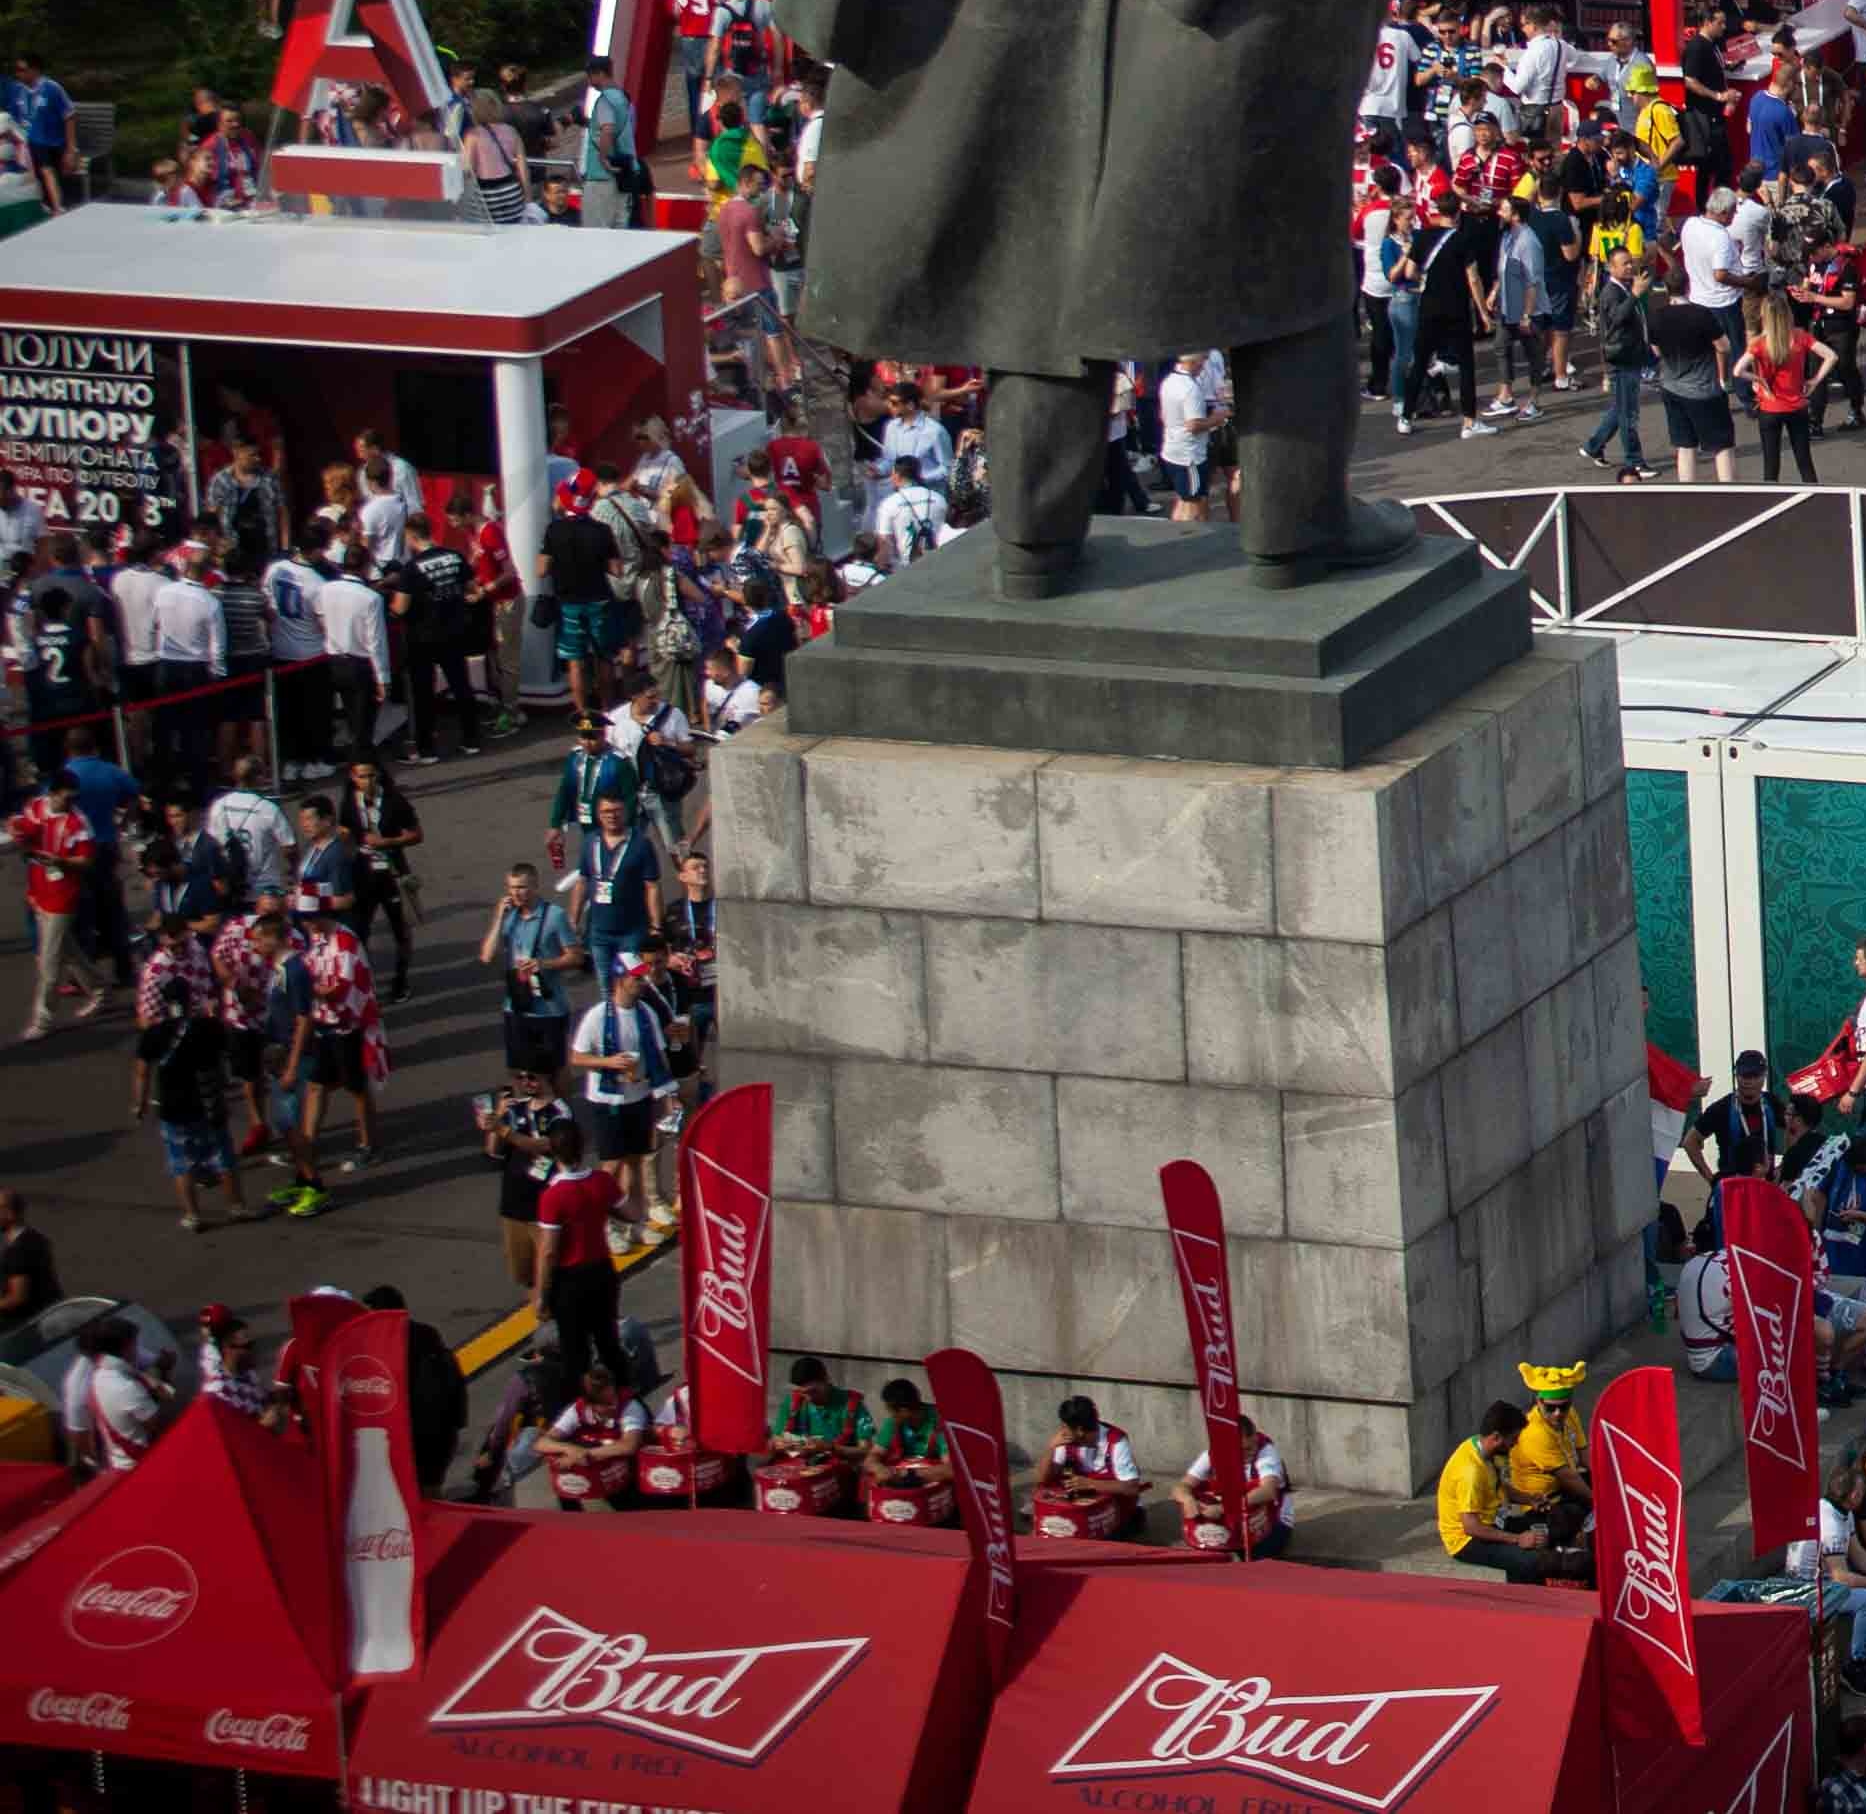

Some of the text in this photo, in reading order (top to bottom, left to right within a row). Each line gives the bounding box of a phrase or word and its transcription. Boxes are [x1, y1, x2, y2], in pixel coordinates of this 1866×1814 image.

[46, 466, 75, 485] ПО
[77, 468, 160, 491] ФУТБОЛУ
[699, 1209, 750, 1338] Bud
[1196, 1277, 1233, 1410] Bud
[1755, 1304, 1789, 1436] Bud
[971, 1474, 1014, 1609] Bud
[1623, 1484, 1677, 1620] Bud
[76, 1582, 192, 1621] Coca-Cola
[28, 1687, 133, 1731] Coca-Cola
[525, 1629, 746, 1718] Bud
[205, 1707, 310, 1753] Coca-Cola
[1146, 1676, 1375, 1766] Bud
[362, 1775, 454, 1814] LIGHT
[461, 1786, 506, 1814] UP
[512, 1792, 574, 1814] THE
